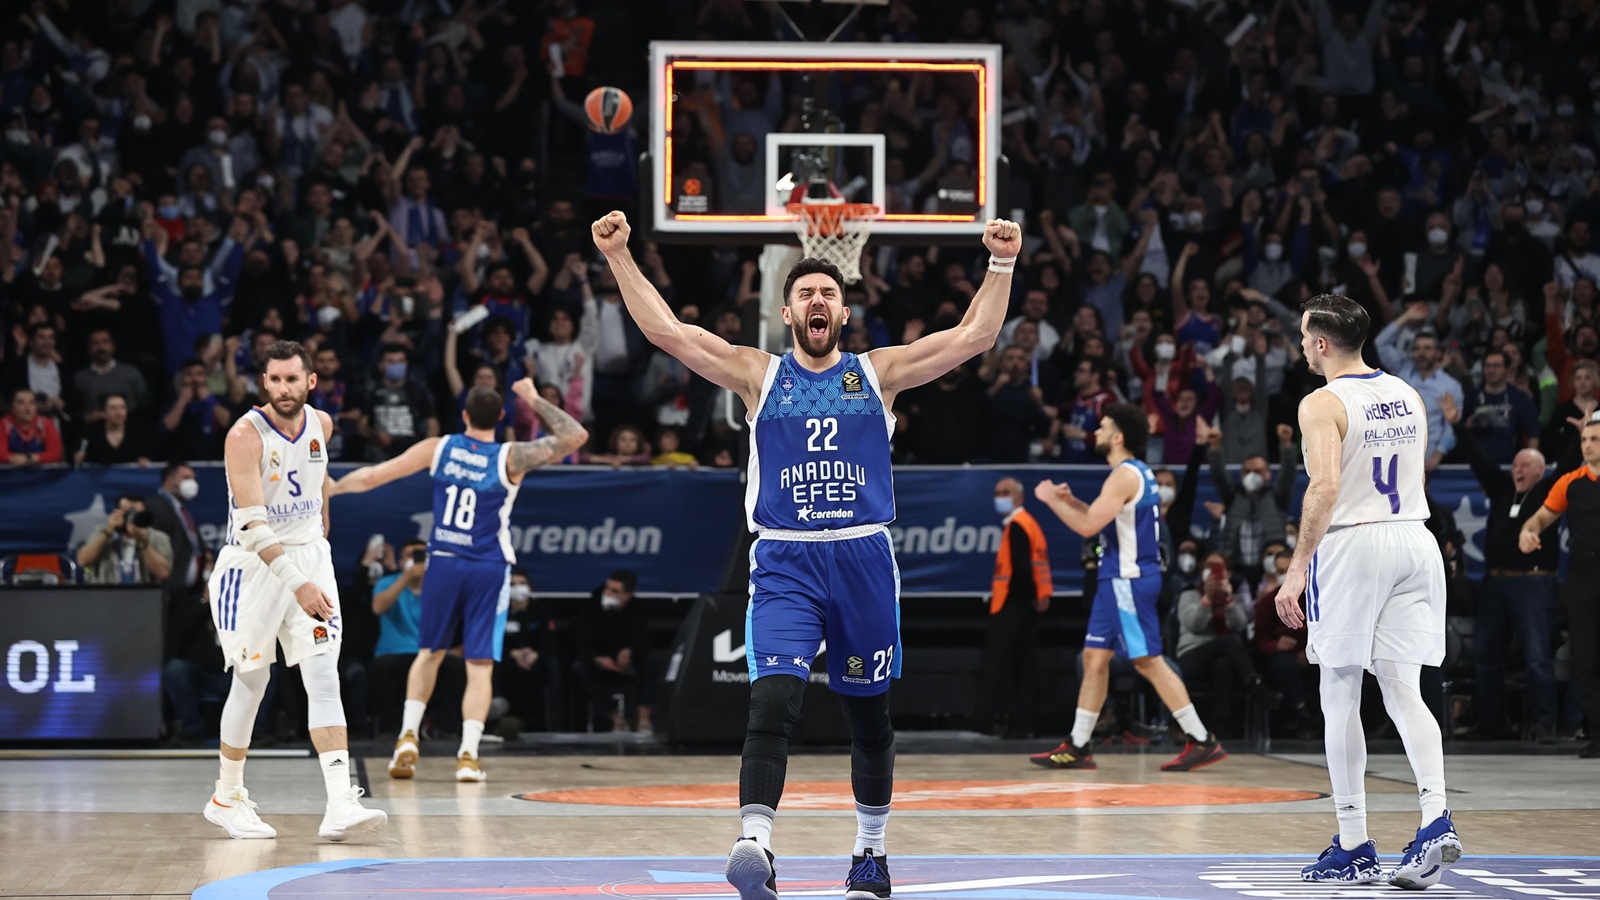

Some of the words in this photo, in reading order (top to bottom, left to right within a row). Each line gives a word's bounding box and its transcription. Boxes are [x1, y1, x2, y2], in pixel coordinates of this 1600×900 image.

[805, 417, 839, 452] 22
[287, 470, 302, 497] 5
[780, 460, 866, 489] ANADOLU
[1372, 454, 1401, 514] 4
[442, 484, 477, 530] 18
[793, 482, 856, 504] EFES
[811, 508, 854, 520] corendon
[510, 517, 662, 554] orendon
